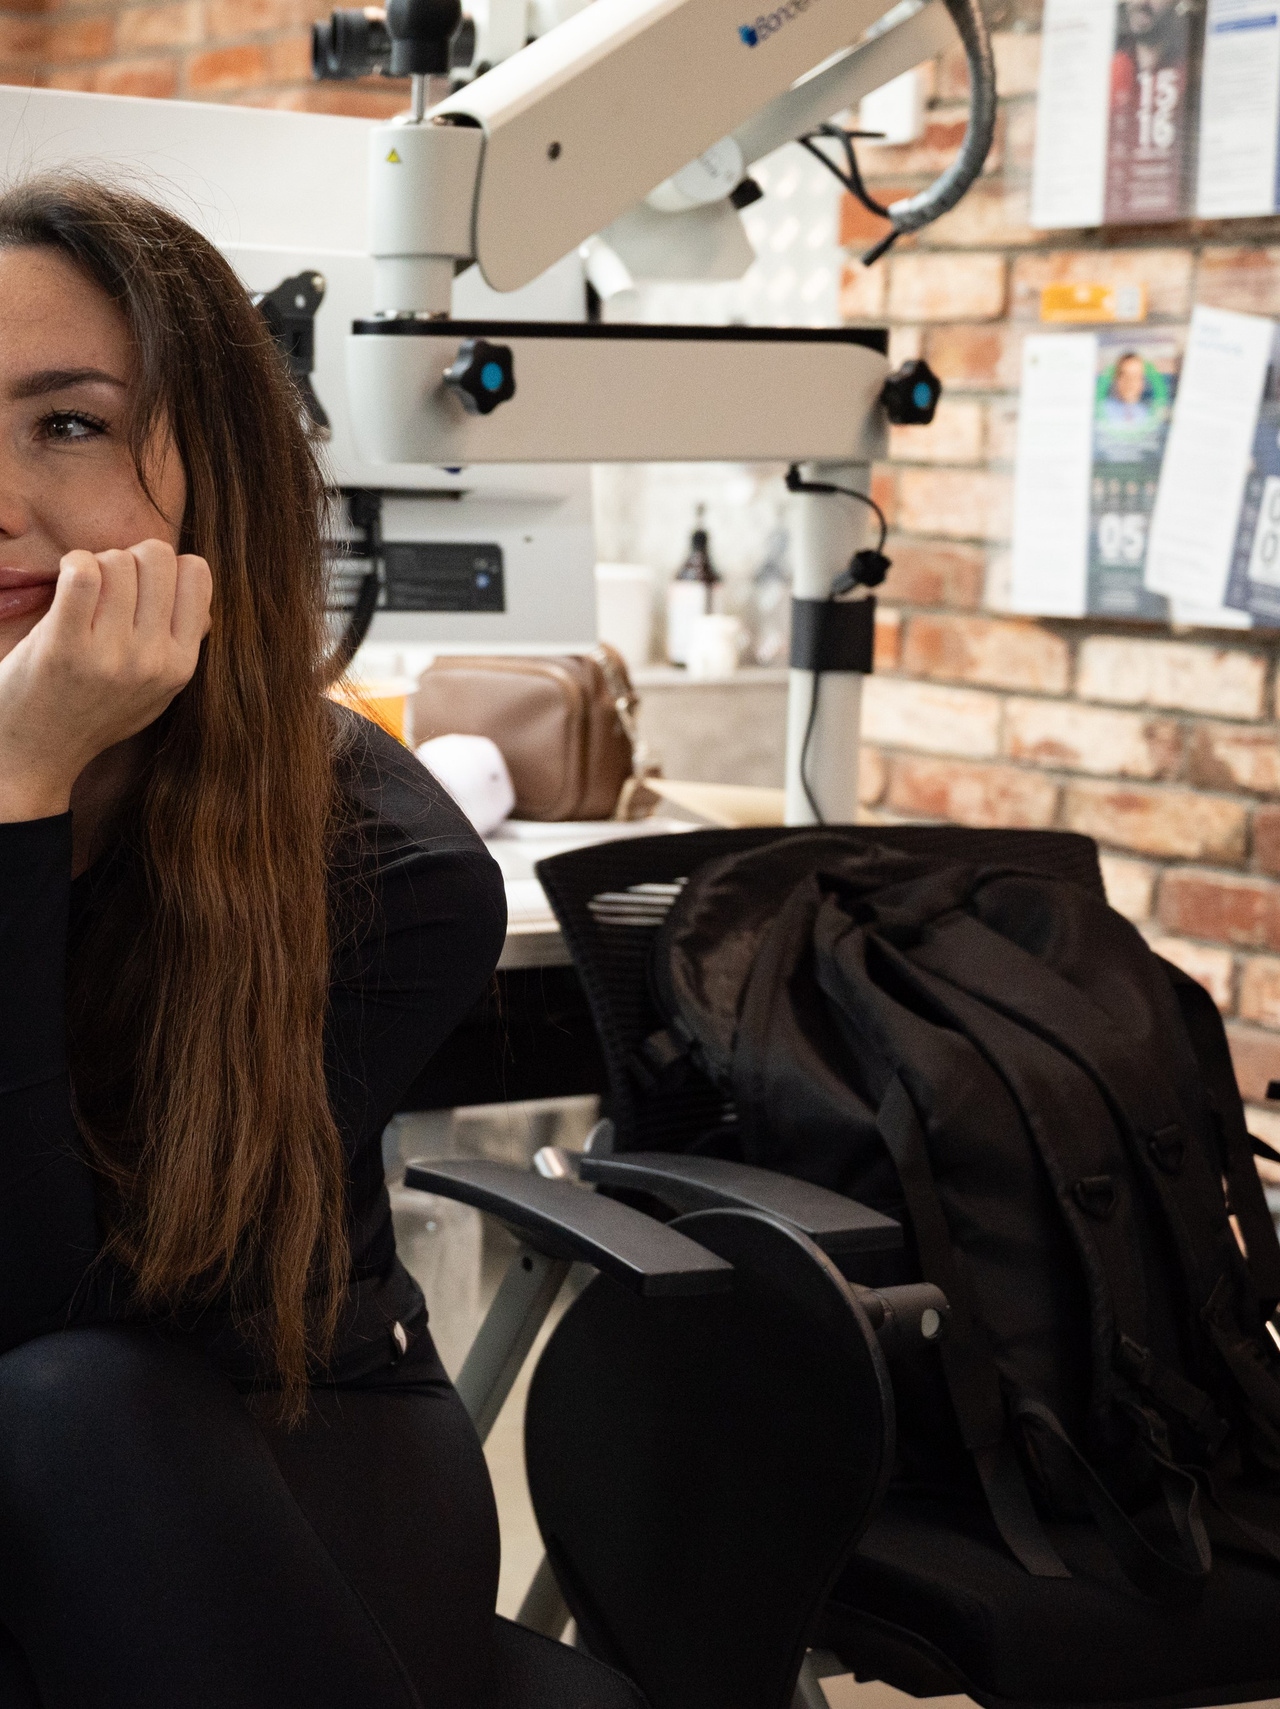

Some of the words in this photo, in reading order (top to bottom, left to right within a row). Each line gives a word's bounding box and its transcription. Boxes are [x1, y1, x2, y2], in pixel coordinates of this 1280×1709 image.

[1136, 67, 1179, 111] 15
[1135, 108, 1177, 149] 16
[1098, 511, 1146, 562] 05
